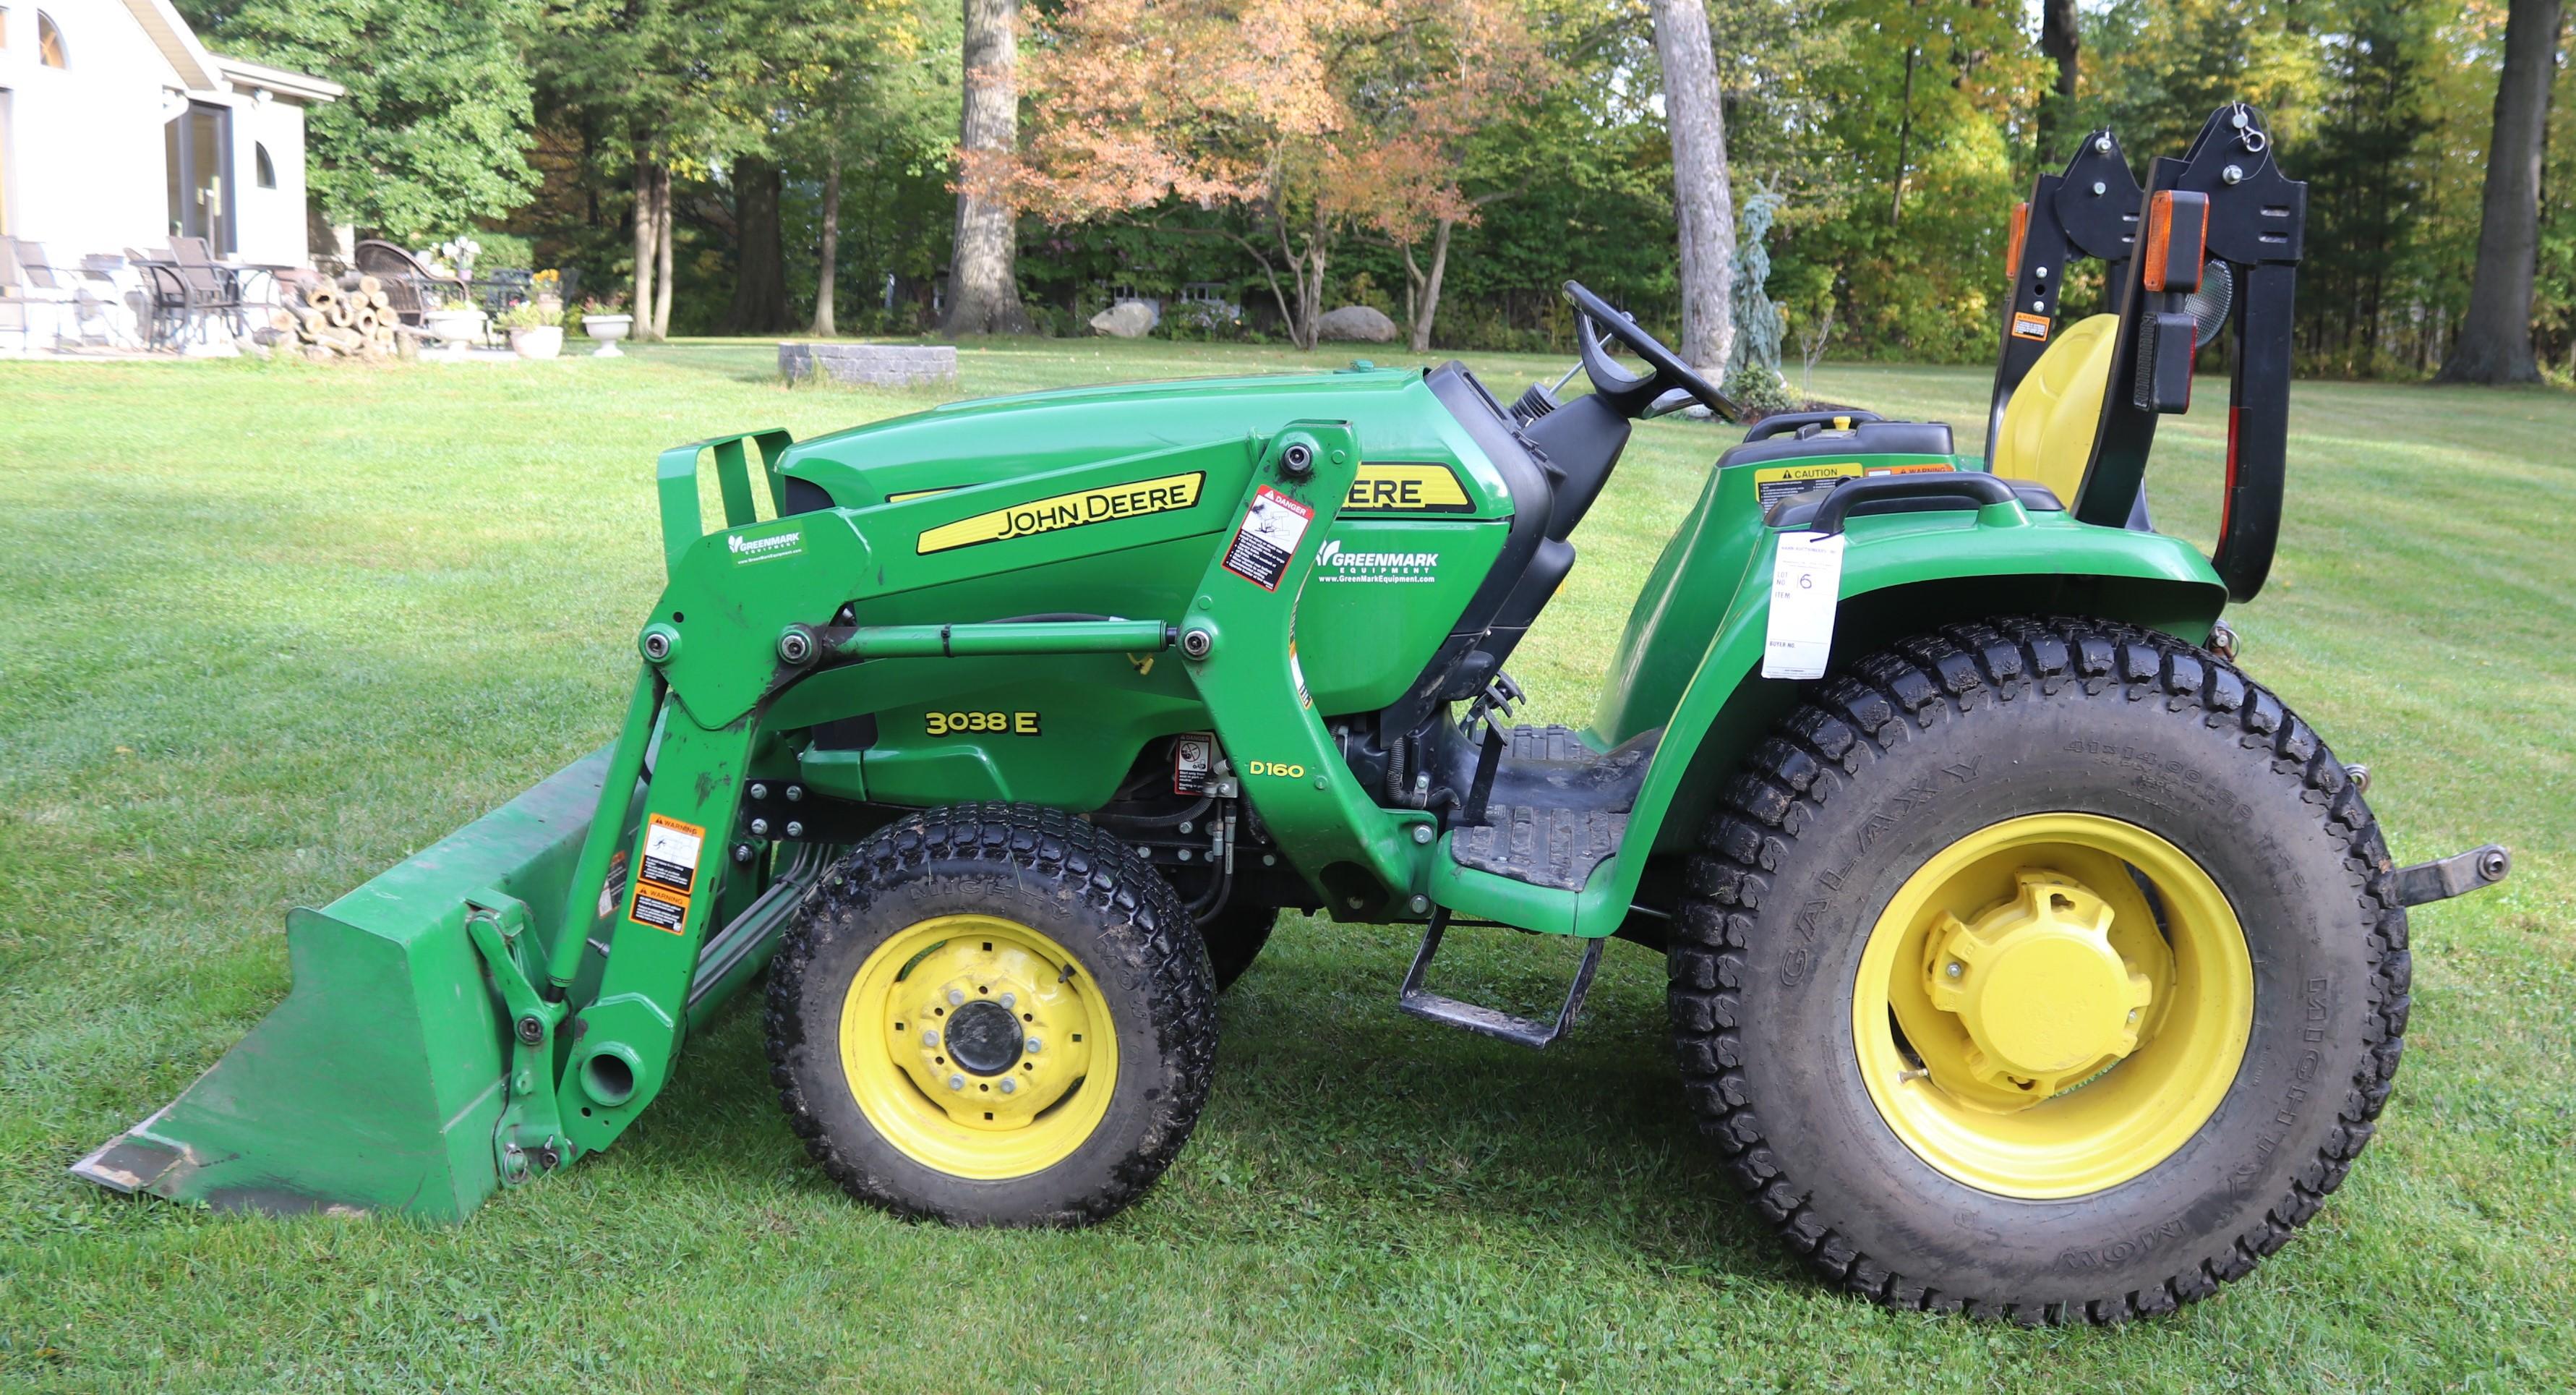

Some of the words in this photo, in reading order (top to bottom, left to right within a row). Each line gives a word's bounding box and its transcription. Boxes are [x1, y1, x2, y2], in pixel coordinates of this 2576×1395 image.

[1795, 469, 1838, 479] CAUTION
[998, 503, 1079, 536] JOHN
[1086, 485, 1188, 519] DEERE
[1275, 495, 1306, 516] DANGER
[740, 532, 800, 552] GREENMARK
[1332, 553, 1439, 567] GREENMARK
[1318, 575, 1435, 584] www.GreenMarkEquipment.com
[1800, 573, 1813, 589] 6
[925, 712, 1008, 735] 3038
[1014, 712, 1039, 734] E
[1249, 761, 1304, 778] D160
[1781, 753, 1985, 987] GALAXY
[649, 890, 683, 904] WARNING
[910, 878, 1073, 921] MIGHTY
[2053, 1219, 2185, 1270] MOW
